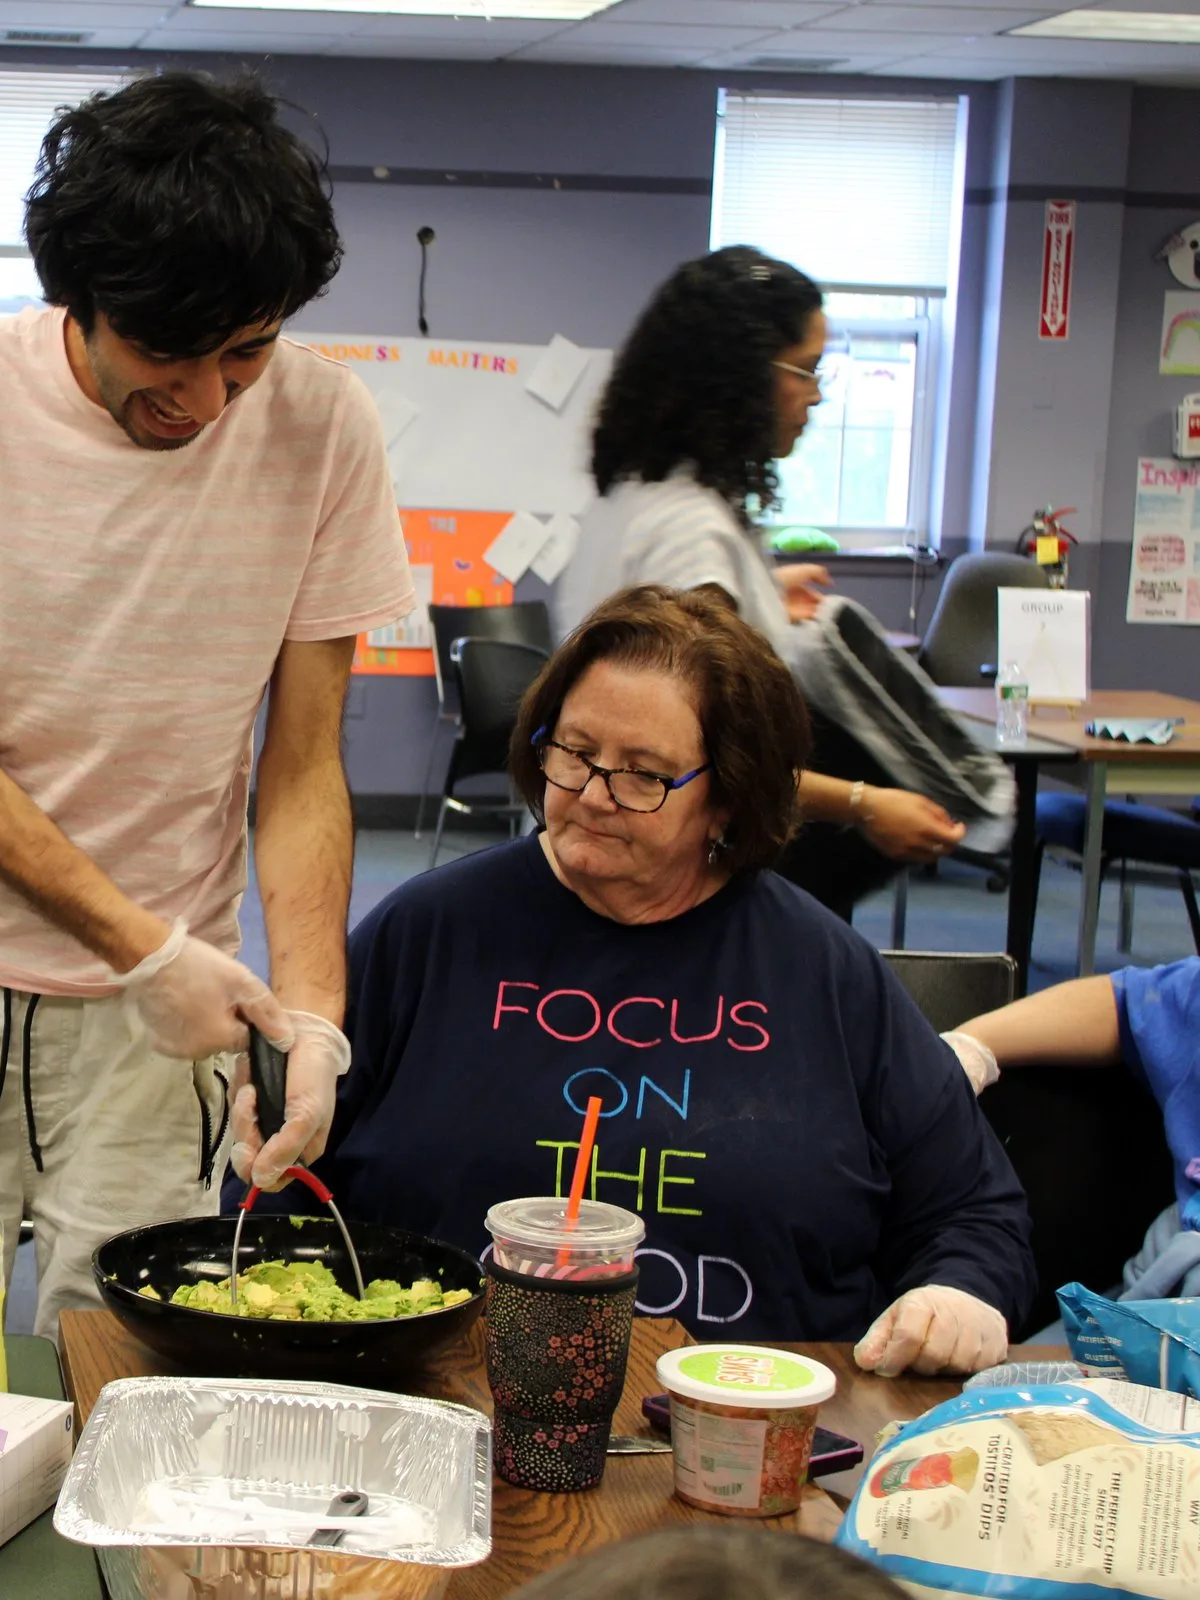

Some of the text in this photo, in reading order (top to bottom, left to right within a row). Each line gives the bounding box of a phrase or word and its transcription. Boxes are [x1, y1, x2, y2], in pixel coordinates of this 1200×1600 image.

[428, 348, 519, 375] MATTERS
[1021, 601, 1064, 615] GROUP
[493, 977, 771, 1052] FOCUS
[562, 1067, 691, 1121] ON
[535, 1139, 707, 1216] THE
[995, 1446, 1013, 1524] CRAFTED FOR
[1189, 1500, 1200, 1526] WAY
[978, 1503, 994, 1541] DIPS
[1092, 1488, 1107, 1550] SINCE 1977
[1103, 1472, 1122, 1575] THE PERFECT CHIP
